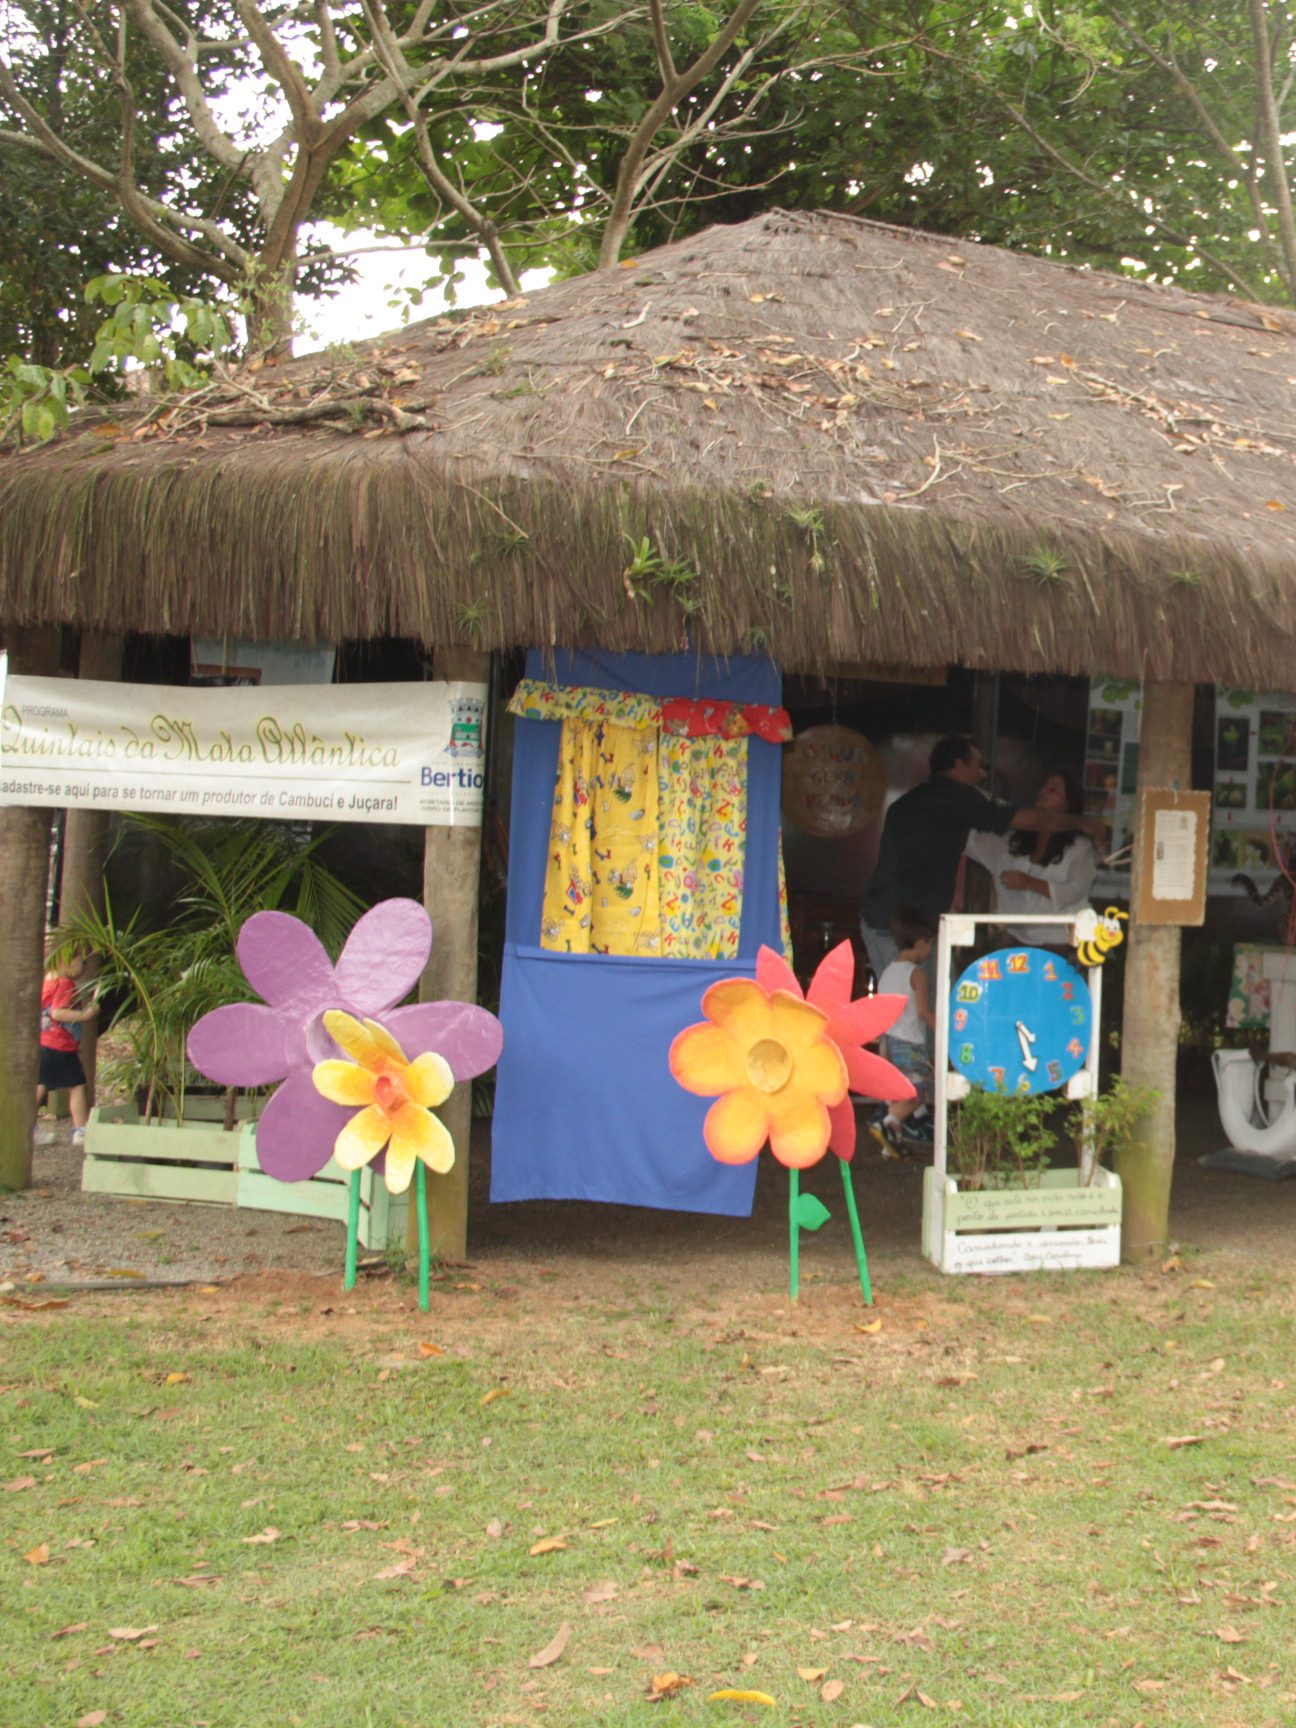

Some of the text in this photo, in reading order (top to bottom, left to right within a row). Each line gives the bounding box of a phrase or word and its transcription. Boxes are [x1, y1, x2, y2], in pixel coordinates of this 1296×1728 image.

[21, 705, 70, 718] PROGRAMA
[1, 704, 402, 767] Quintais da Mata Atlântica
[0, 780, 398, 813] adastre-se aqui para se tornar um produtor de Cambuci e Juçara!
[978, 960, 1002, 980] 11
[1008, 953, 1029, 973] 12
[1044, 961, 1058, 981] 1
[957, 981, 982, 1003] 10
[1062, 982, 1073, 1000] 2
[954, 1009, 967, 1031] 9
[1071, 1006, 1085, 1025] 3
[961, 1043, 974, 1065] 8
[1067, 1038, 1083, 1058] 4
[988, 1066, 1005, 1083] 7
[1047, 1061, 1062, 1082] 5
[1018, 1073, 1030, 1092] 6
